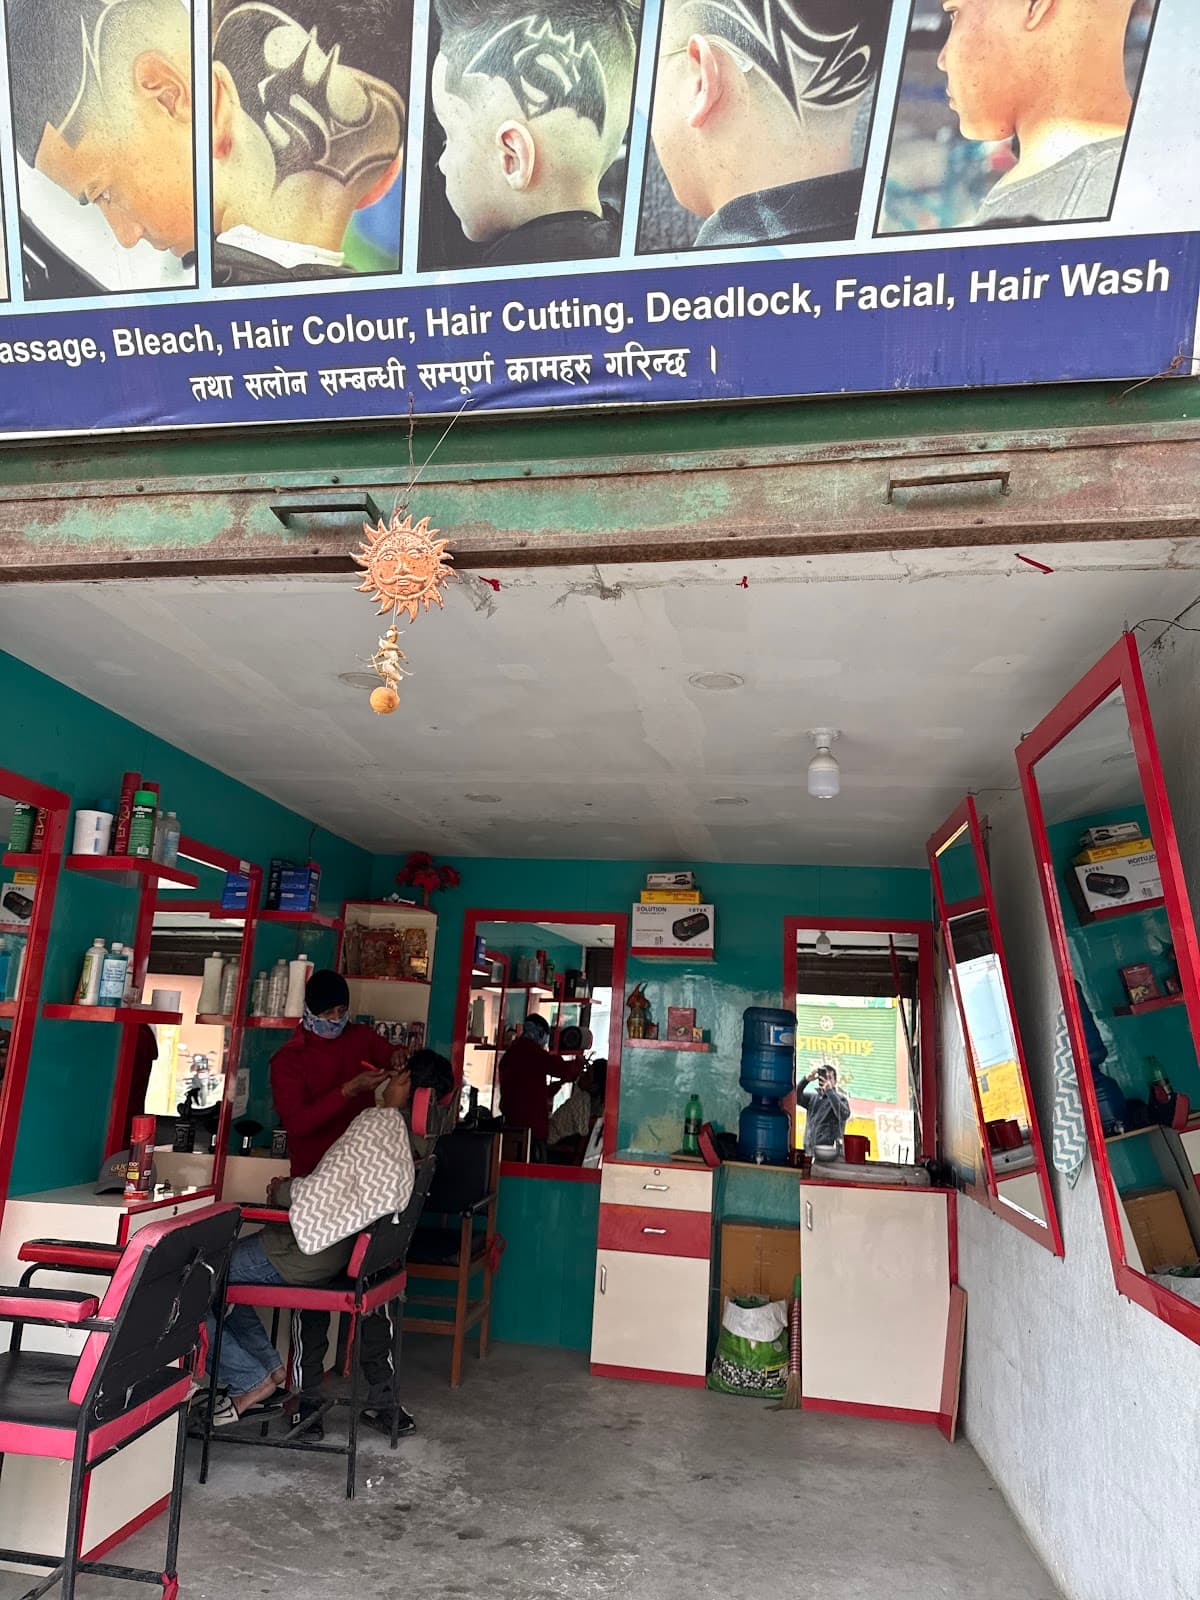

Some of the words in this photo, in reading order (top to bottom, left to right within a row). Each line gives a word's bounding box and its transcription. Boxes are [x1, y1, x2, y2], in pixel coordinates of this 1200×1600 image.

[113, 323, 222, 358] Bleach,
[231, 318, 294, 349] Hair
[303, 314, 415, 345] Colour,
[426, 305, 492, 338] Hair
[503, 298, 633, 333] Cutting.
[647, 283, 820, 322] Deadlock,
[836, 273, 954, 312] Facial,
[970, 273, 1049, 303] Hair
[1061, 258, 1169, 297] Wash
[189, 375, 234, 401] तथा
[243, 366, 308, 400] सलोन
[318, 356, 406, 396] सम्बन्धी
[417, 351, 494, 395] सम्पूर्ण
[505, 353, 593, 386] कामहरु
[603, 341, 691, 380] गरिन्छ
